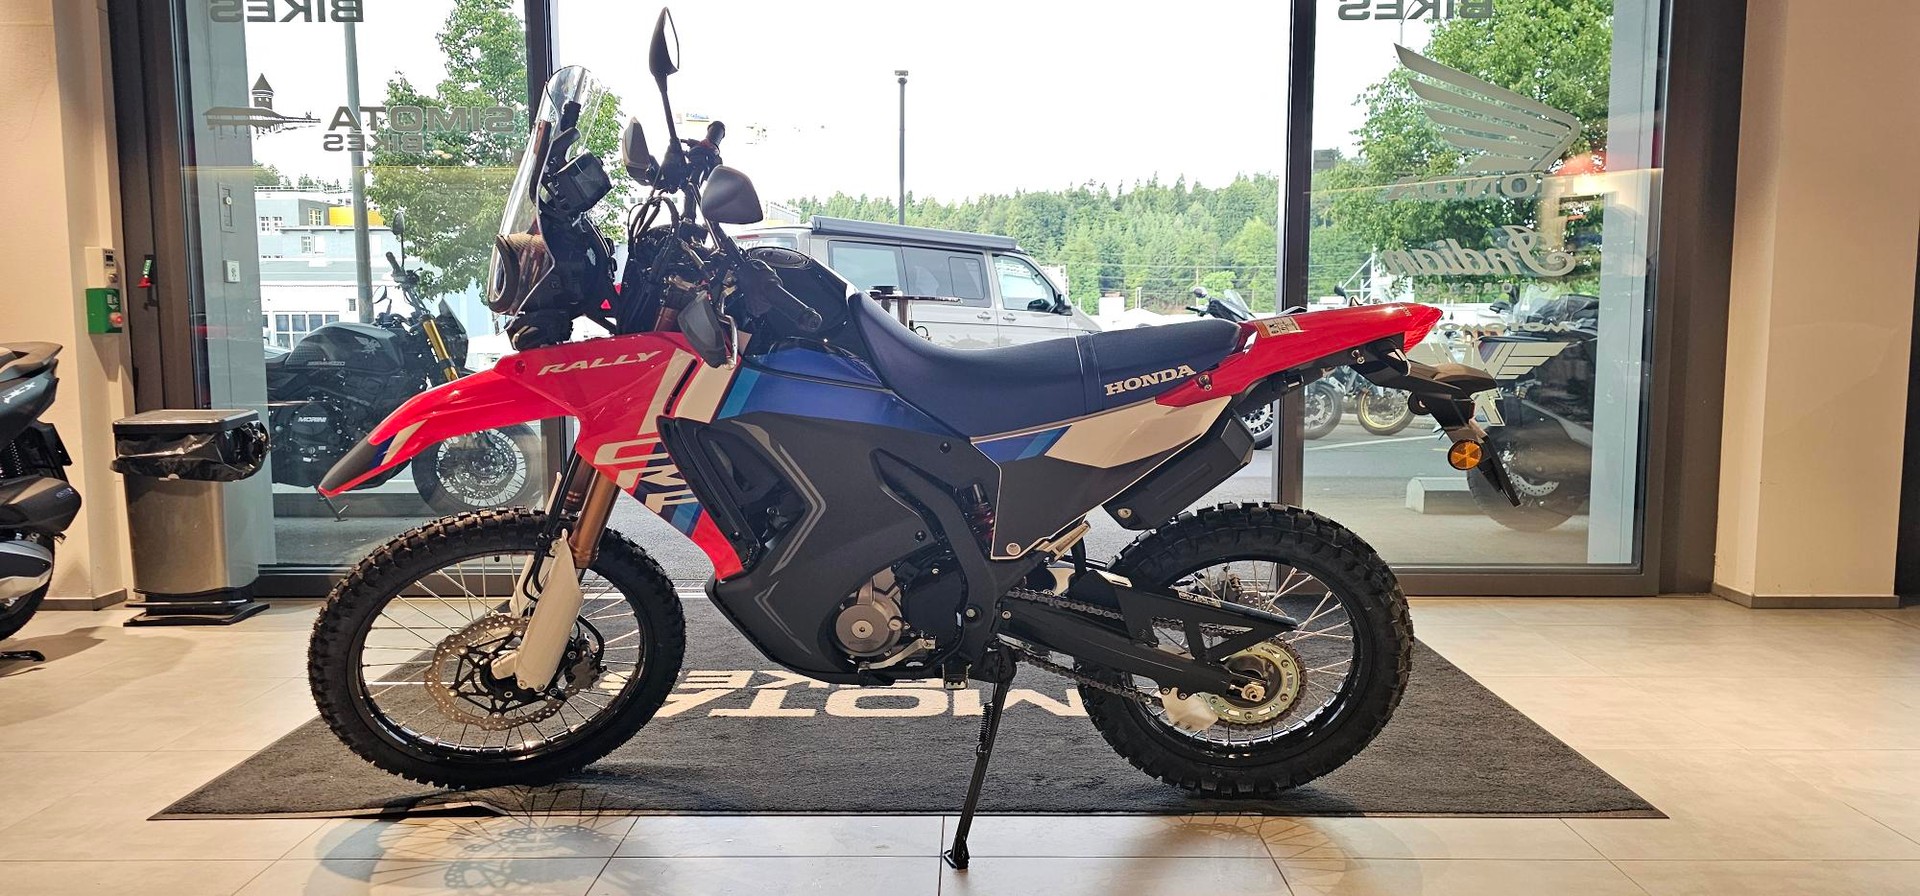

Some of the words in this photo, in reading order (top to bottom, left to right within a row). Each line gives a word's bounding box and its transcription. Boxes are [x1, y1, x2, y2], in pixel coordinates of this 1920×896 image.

[537, 350, 662, 376] RALLY
[1104, 364, 1197, 396] HONDA
[297, 416, 328, 424] MORINI
